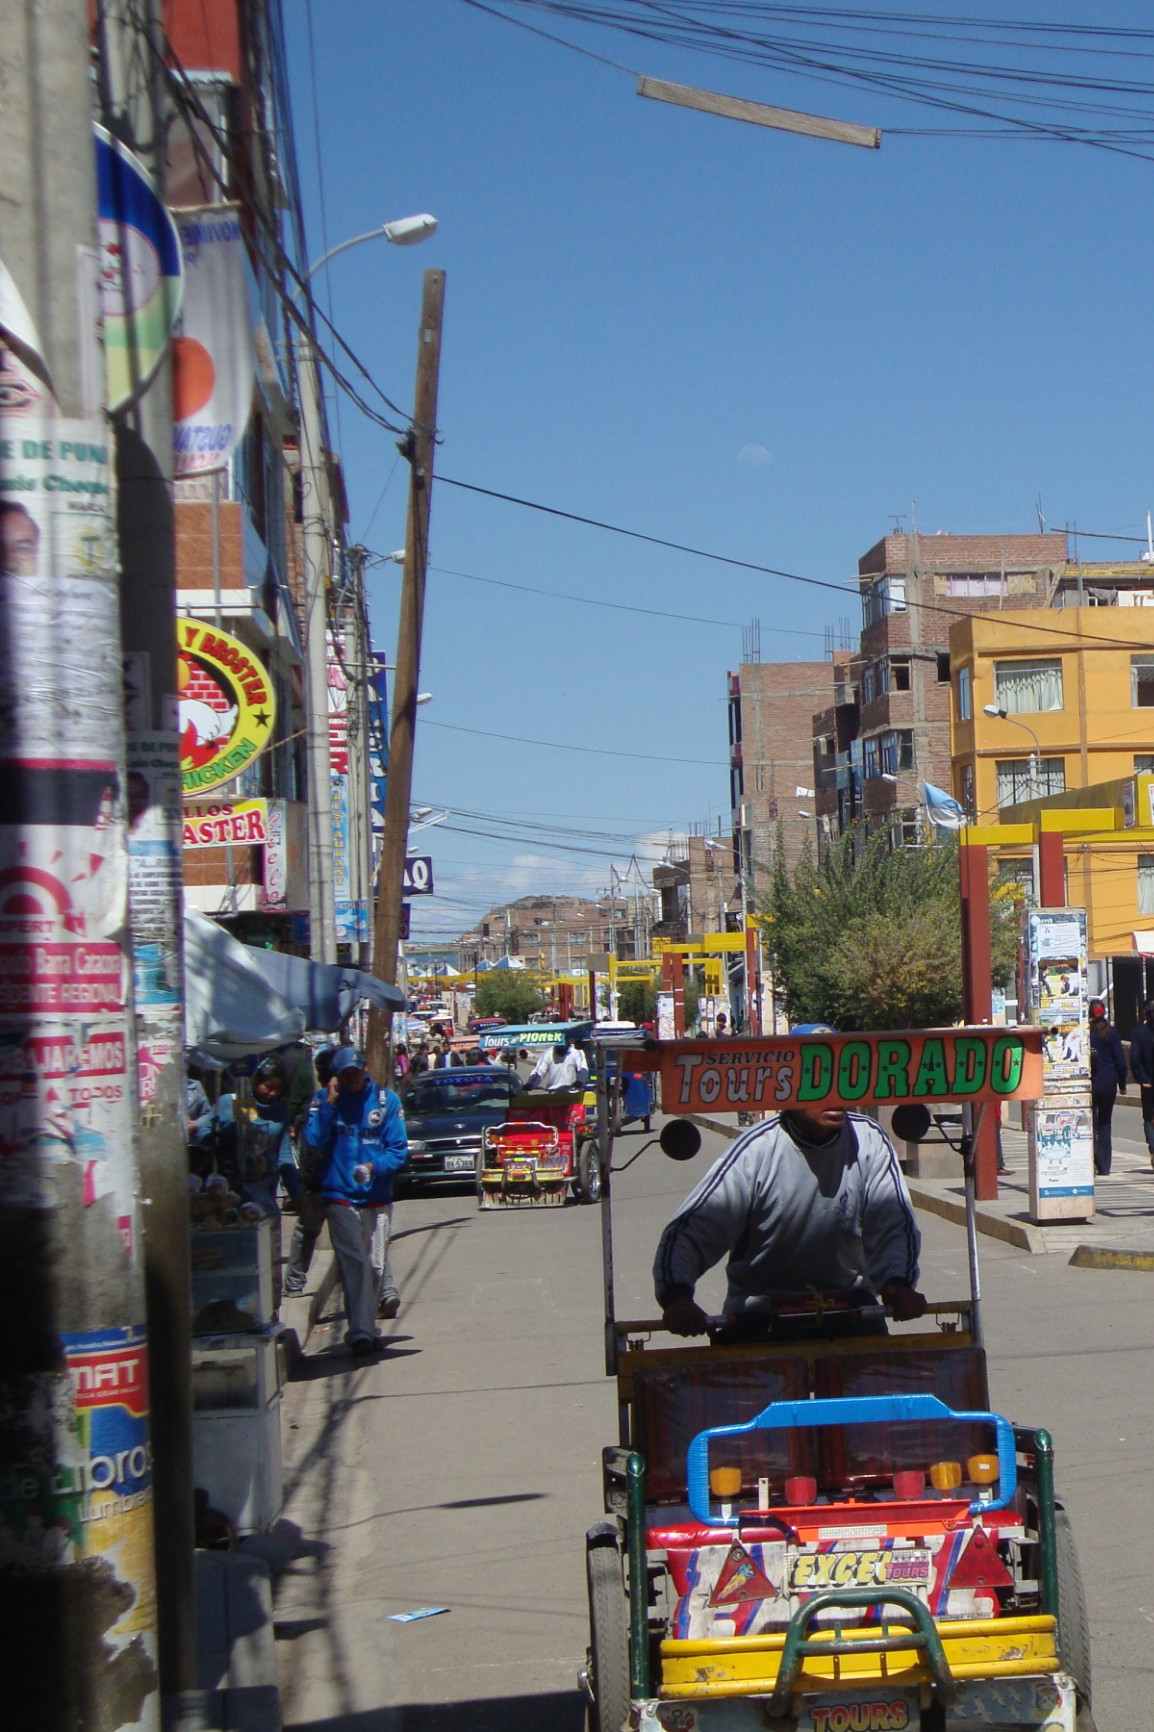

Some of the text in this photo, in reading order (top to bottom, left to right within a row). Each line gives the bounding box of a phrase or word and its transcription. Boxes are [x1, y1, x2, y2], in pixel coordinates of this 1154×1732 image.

[185, 626, 267, 706] Y BROSTER
[333, 793, 345, 886] RESTAURANT
[484, 1035, 510, 1047] Tours
[706, 1050, 795, 1065] SERVICIO
[433, 1076, 493, 1085] TOYOTA
[675, 1036, 1024, 1103] Tours DORADO
[885, 1562, 929, 1579] TOURS
[810, 1702, 908, 1732] TOURS
